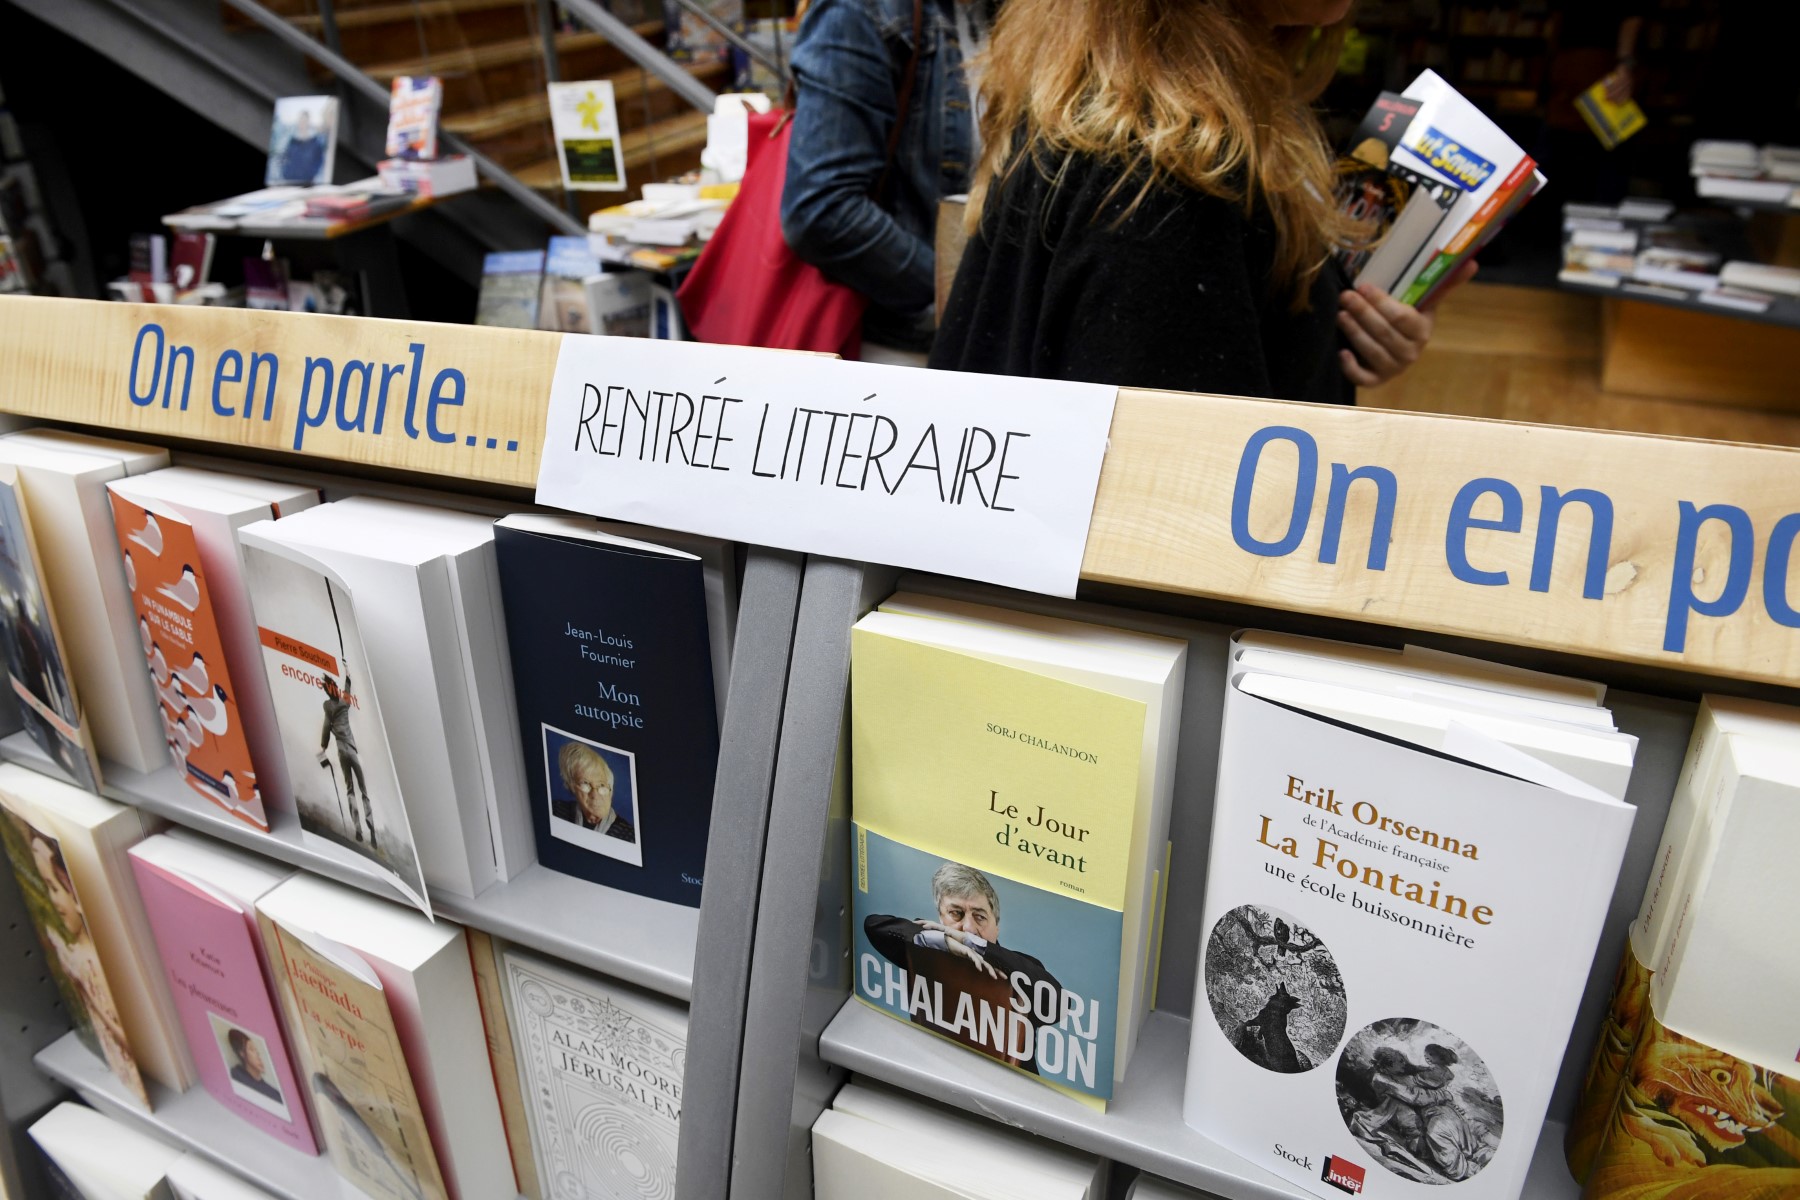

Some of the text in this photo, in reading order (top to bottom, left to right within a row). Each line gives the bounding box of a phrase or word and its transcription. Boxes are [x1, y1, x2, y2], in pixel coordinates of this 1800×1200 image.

[128, 323, 519, 452] On en parle...
[574, 376, 1031, 512] RENTRÉE LITTÉRAIRE
[1230, 425, 1398, 571] On
[1445, 477, 1614, 600] en
[274, 636, 331, 669] Pierre Souchon
[565, 621, 633, 650] Jean-Louis
[581, 645, 636, 669] Fournier
[281, 663, 323, 690] encore
[598, 681, 640, 707] Mon
[574, 702, 644, 729] autopsie
[986, 722, 1099, 765] SORJ CHALANDON
[988, 790, 1090, 843] Le Jour
[1283, 774, 1480, 862] Erik Orsenna
[996, 824, 1087, 874] d'avant
[1302, 814, 1450, 873] de l'Académie française
[681, 872, 703, 886] Stoc
[1059, 879, 1086, 894] roman
[1256, 814, 1494, 926] La Fontaine
[1264, 861, 1475, 949] une école buissonnière
[860, 952, 1097, 1089] CHALANDON
[1009, 970, 1099, 1041] SORJ
[552, 1030, 681, 1098] ALAN MOORE
[1273, 1143, 1312, 1172] Stock
[1329, 1169, 1361, 1192] inter
